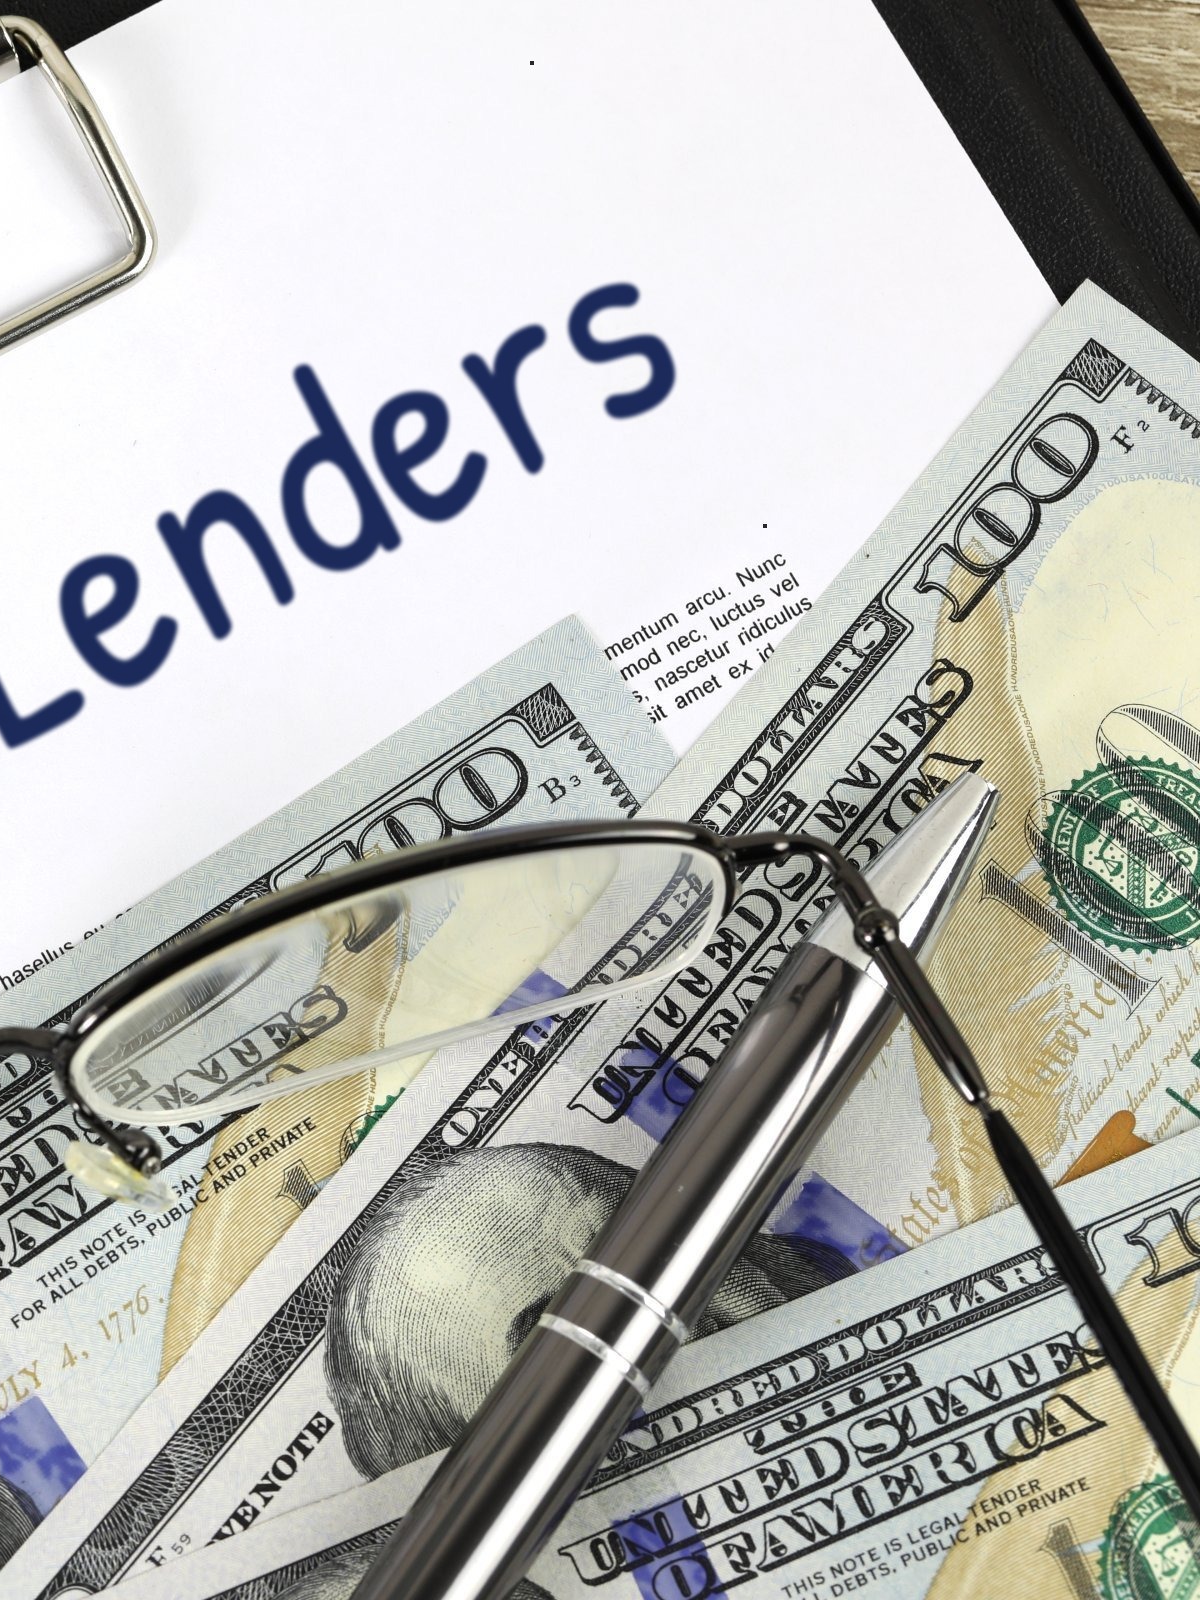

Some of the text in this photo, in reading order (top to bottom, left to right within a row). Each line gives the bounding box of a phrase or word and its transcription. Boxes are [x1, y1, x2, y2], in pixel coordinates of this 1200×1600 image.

[913, 411, 1100, 623] 100
[603, 612, 680, 662] mentum
[684, 585, 733, 616] arcu.
[735, 552, 788, 588] Nunc
[619, 648, 663, 682] mod
[709, 592, 766, 632] luctus
[769, 572, 801, 599] vel
[654, 639, 732, 693] nascetur
[737, 597, 814, 647] ridiculus
[673, 674, 724, 710] amet
[728, 659, 755, 681] ex
[566, 887, 784, 1125] UNITED
[441, 1046, 534, 1149] ONE
[10, 1298, 48, 1330] FOR
[49, 1277, 84, 1304] ALL
[147, 1190, 211, 1237] PUBLIC
[213, 1166, 249, 1194] AND
[249, 1116, 318, 1168] PRIVATE
[36, 1255, 79, 1289] THIS
[79, 1224, 128, 1262] NOTE
[128, 1209, 148, 1226] IS
[202, 1126, 272, 1173] TENDER
[258, 1410, 337, 1510] NOTE
[557, 1435, 851, 1587] UNITED
[755, 1393, 1109, 1574] AMERICA
[781, 1477, 1044, 1600] THIS NOTE IS LEGAL TENDER
[901, 1530, 971, 1568] PUBLIC
[974, 1508, 1013, 1537] AND
[1016, 1476, 1093, 1518] PRIVATE
